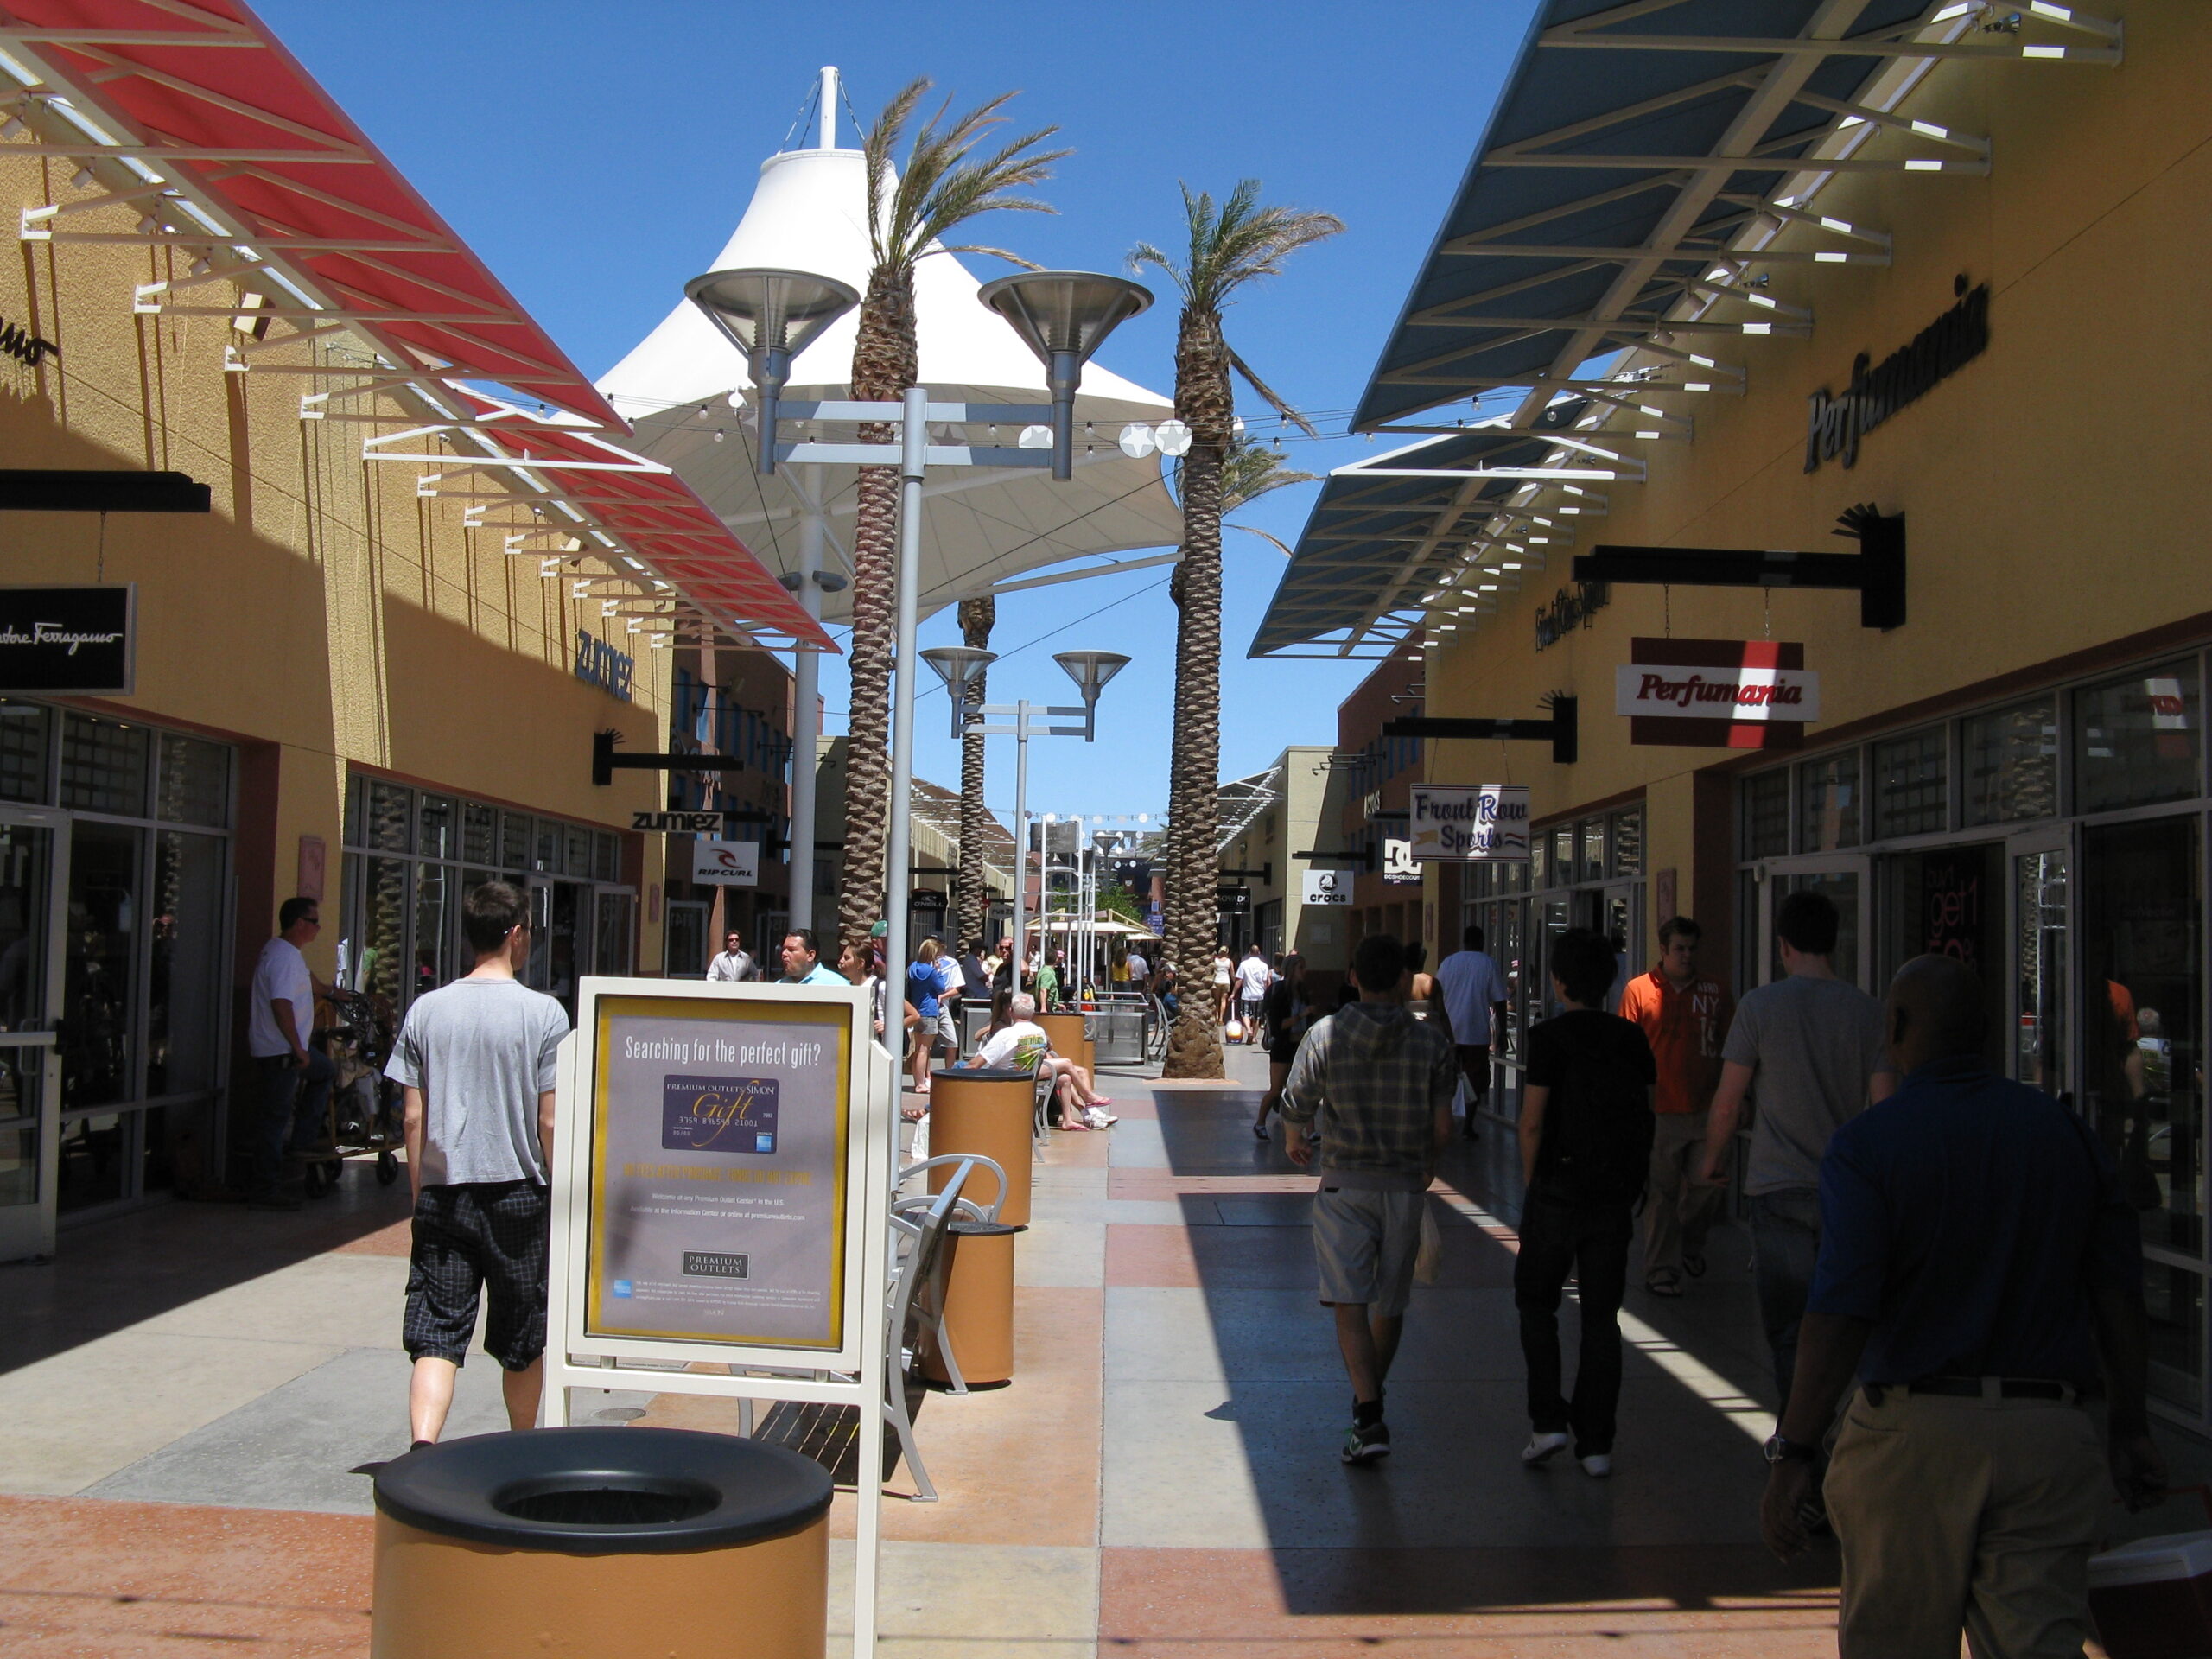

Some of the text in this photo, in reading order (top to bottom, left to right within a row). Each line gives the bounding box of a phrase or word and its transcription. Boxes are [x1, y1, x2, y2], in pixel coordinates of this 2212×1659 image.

[34, 622, 123, 655] Ferragamo
[1637, 674, 1802, 707] Perfumania
[1415, 794, 1528, 821] Front Row
[1440, 825, 1502, 853] Sports
[1310, 893, 1346, 902] crocs
[626, 1036, 821, 1070] Searching for the perfect gift?
[708, 1084, 745, 1093] OUTLETS
[747, 1084, 775, 1095] SIMON
[691, 1080, 754, 1147] Gift
[689, 1255, 742, 1266] PREMIUM
[690, 1264, 741, 1274] OUTLETS
